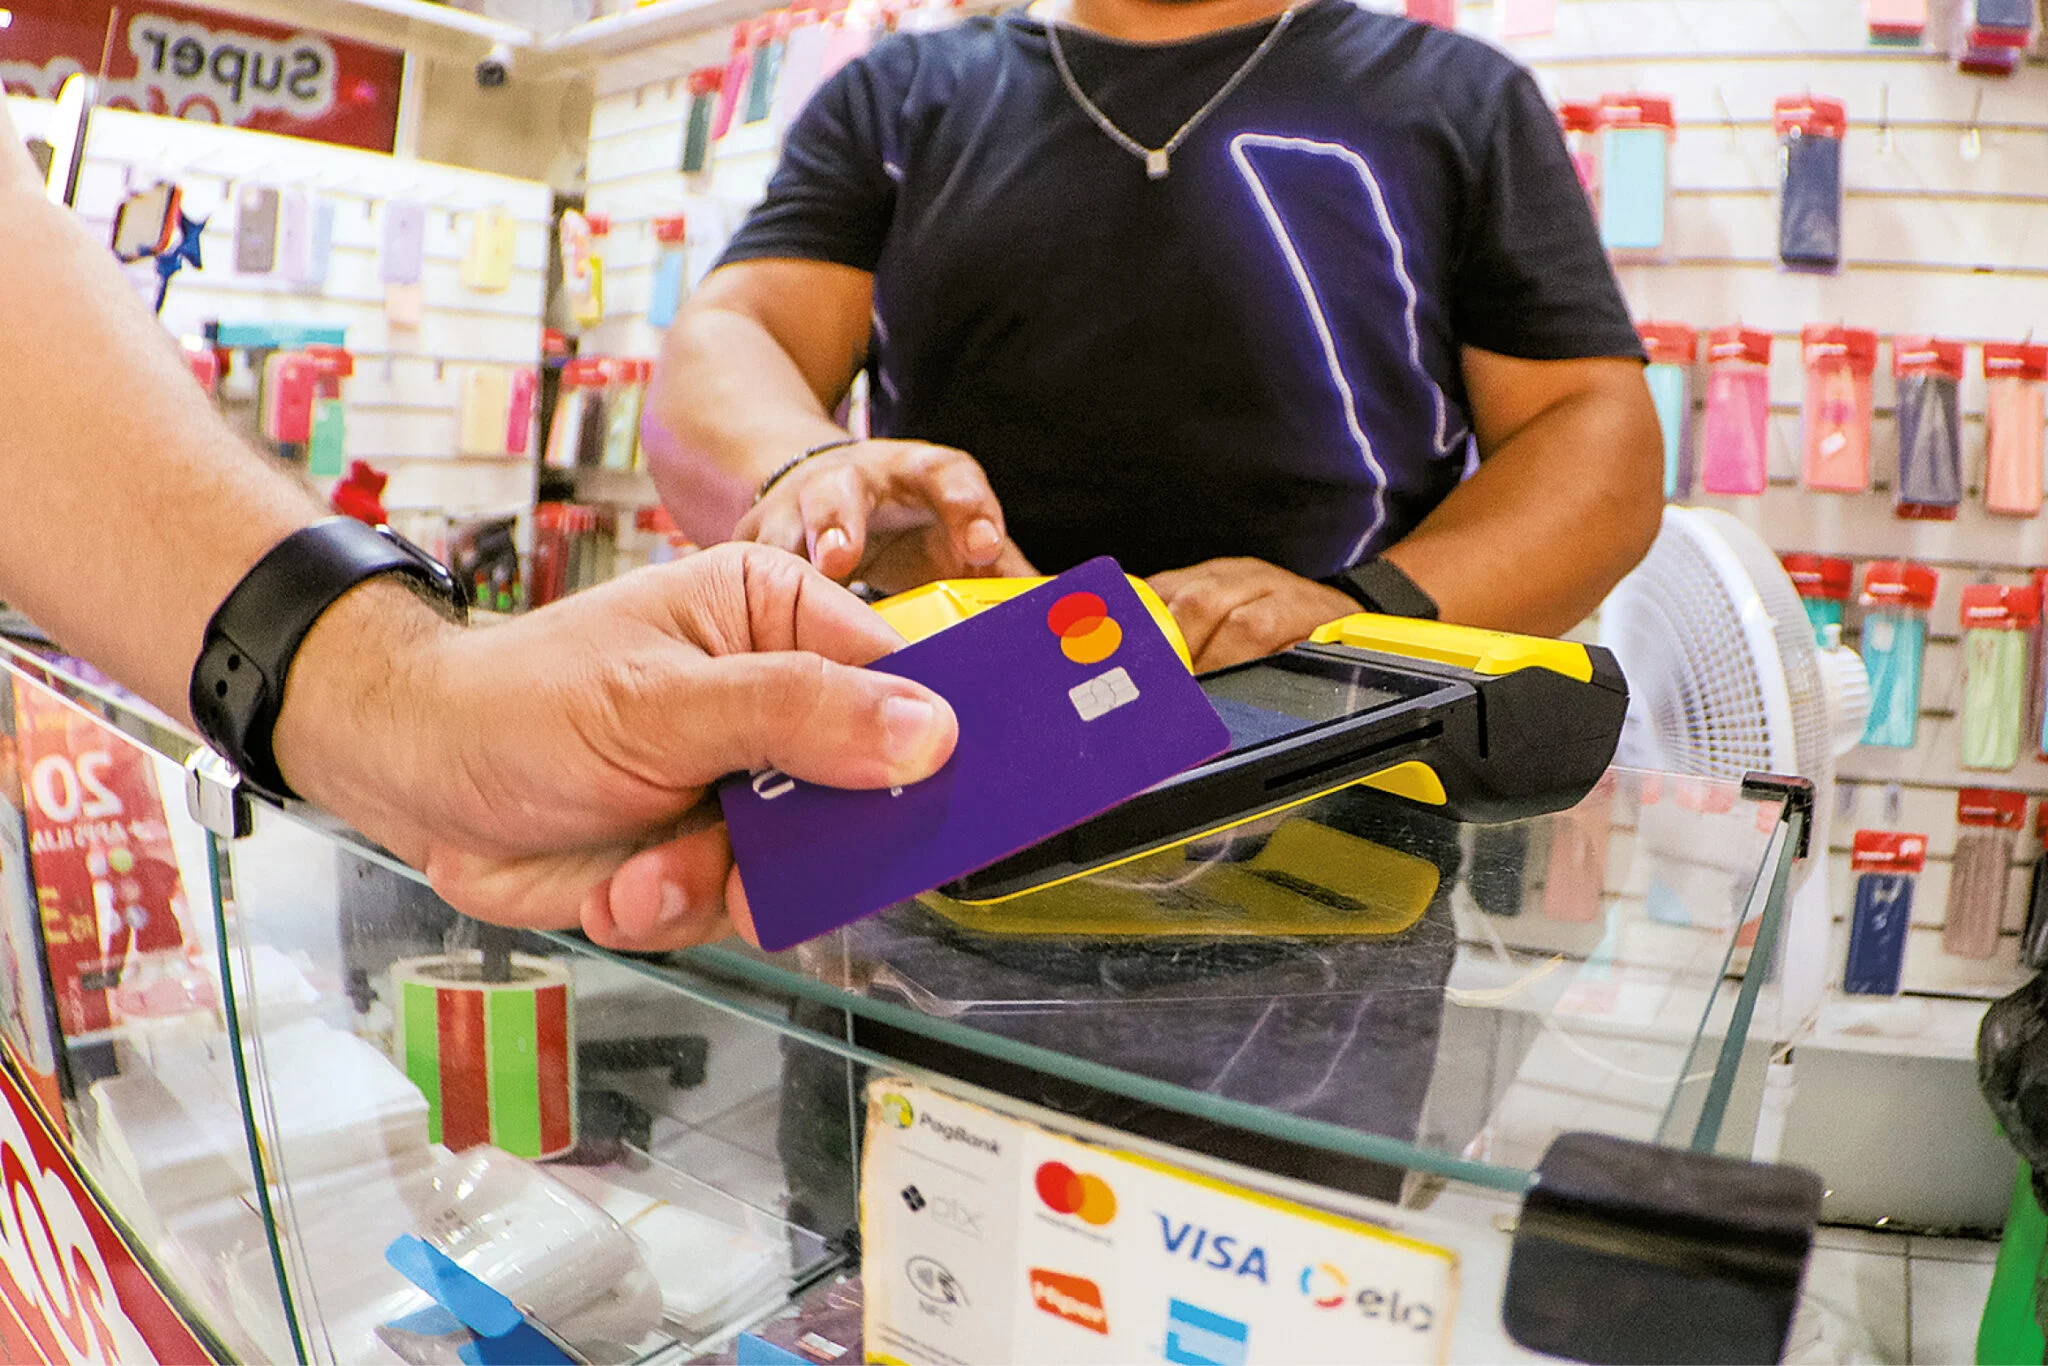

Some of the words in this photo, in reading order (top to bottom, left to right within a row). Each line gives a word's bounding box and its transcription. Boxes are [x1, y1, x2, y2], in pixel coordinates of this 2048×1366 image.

[920, 1112, 999, 1156] PagBank
[1155, 1211, 1268, 1285] VISA
[1356, 1288, 1433, 1332] elo
